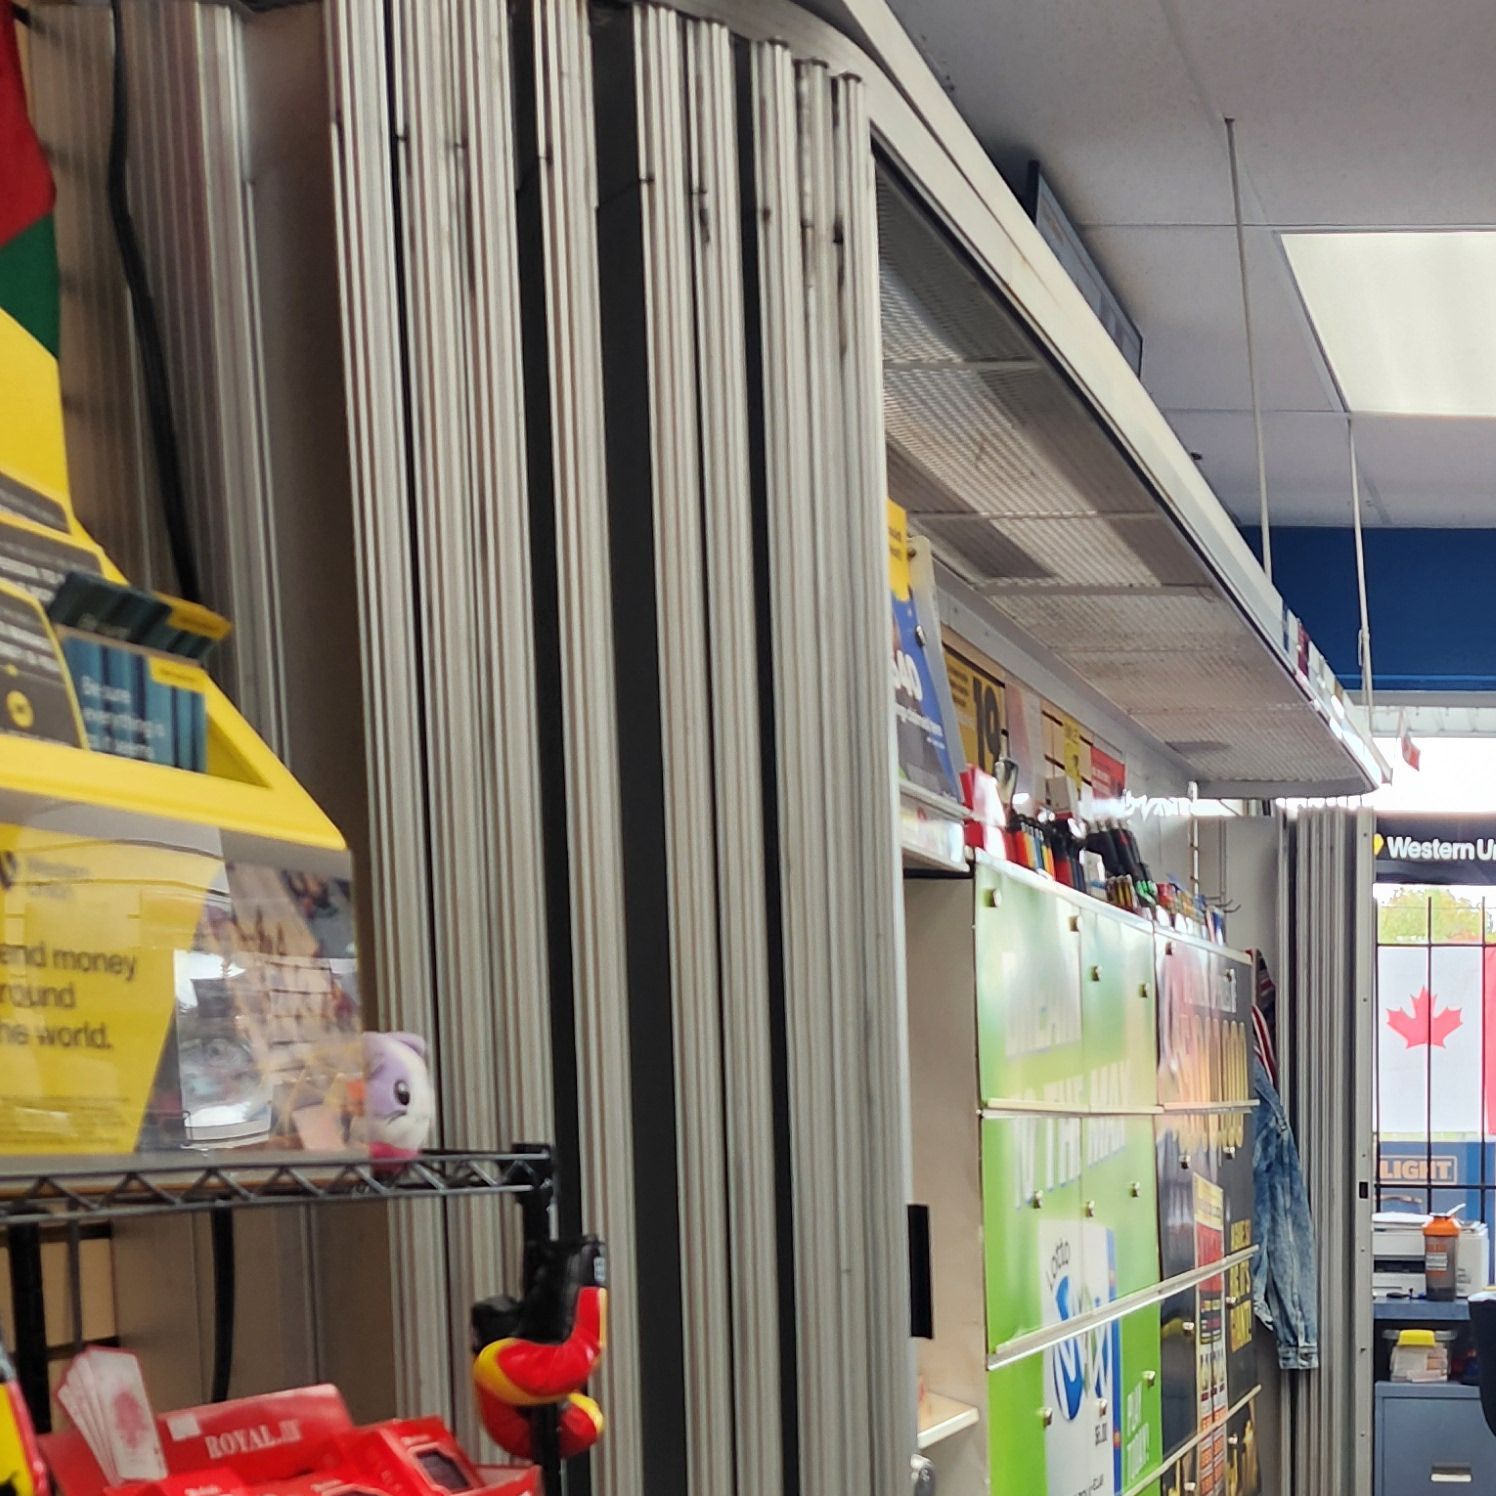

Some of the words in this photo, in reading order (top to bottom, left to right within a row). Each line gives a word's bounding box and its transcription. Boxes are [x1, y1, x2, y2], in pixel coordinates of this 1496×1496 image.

[1387, 836, 1475, 862] Western
[0, 941, 47, 969] end
[53, 948, 137, 983] money
[0, 983, 76, 1009] round
[0, 1021, 28, 1046] he
[205, 1424, 278, 1460] ROYAL
